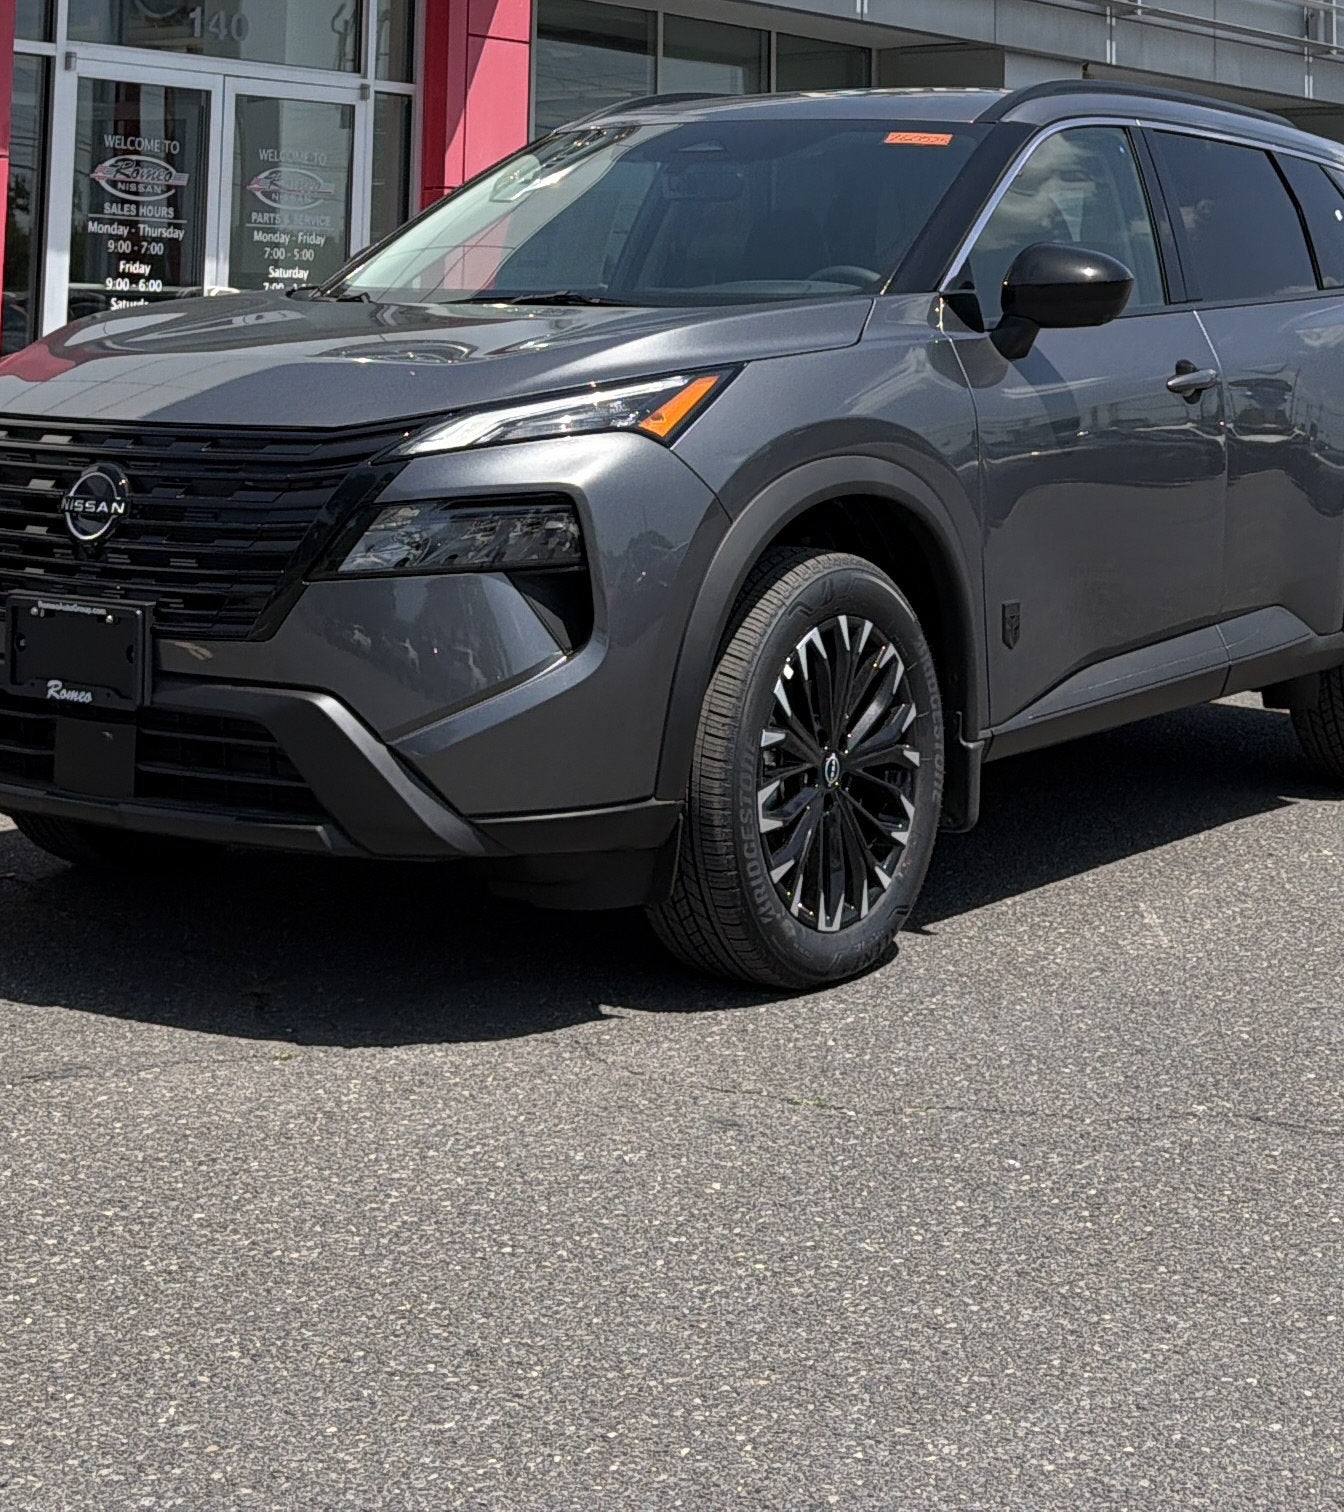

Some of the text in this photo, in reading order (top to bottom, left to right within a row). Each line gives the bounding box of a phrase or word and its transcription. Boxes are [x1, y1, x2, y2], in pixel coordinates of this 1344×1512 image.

[189, 6, 250, 42] 140
[103, 134, 180, 155] WELCOME TO
[110, 157, 173, 183] Romeo
[117, 181, 162, 194] NISSAN
[103, 201, 175, 218] SALES HOURS
[251, 211, 281, 224] PARTS
[87, 220, 130, 238] Monday
[138, 223, 185, 241] Thursday
[253, 230, 291, 246] Monday
[298, 231, 326, 248] Friday
[107, 239, 132, 254] 9:00
[140, 241, 164, 256] 7:00
[263, 248, 286, 260] 7:00
[293, 248, 315, 262] 5:00
[118, 260, 152, 277] Friday
[268, 265, 310, 281] Saturday
[105, 277, 130, 291] 9:00
[138, 278, 163, 293] 6:00
[61, 496, 125, 514] NISSAN
[46, 679, 93, 703] Romeo
